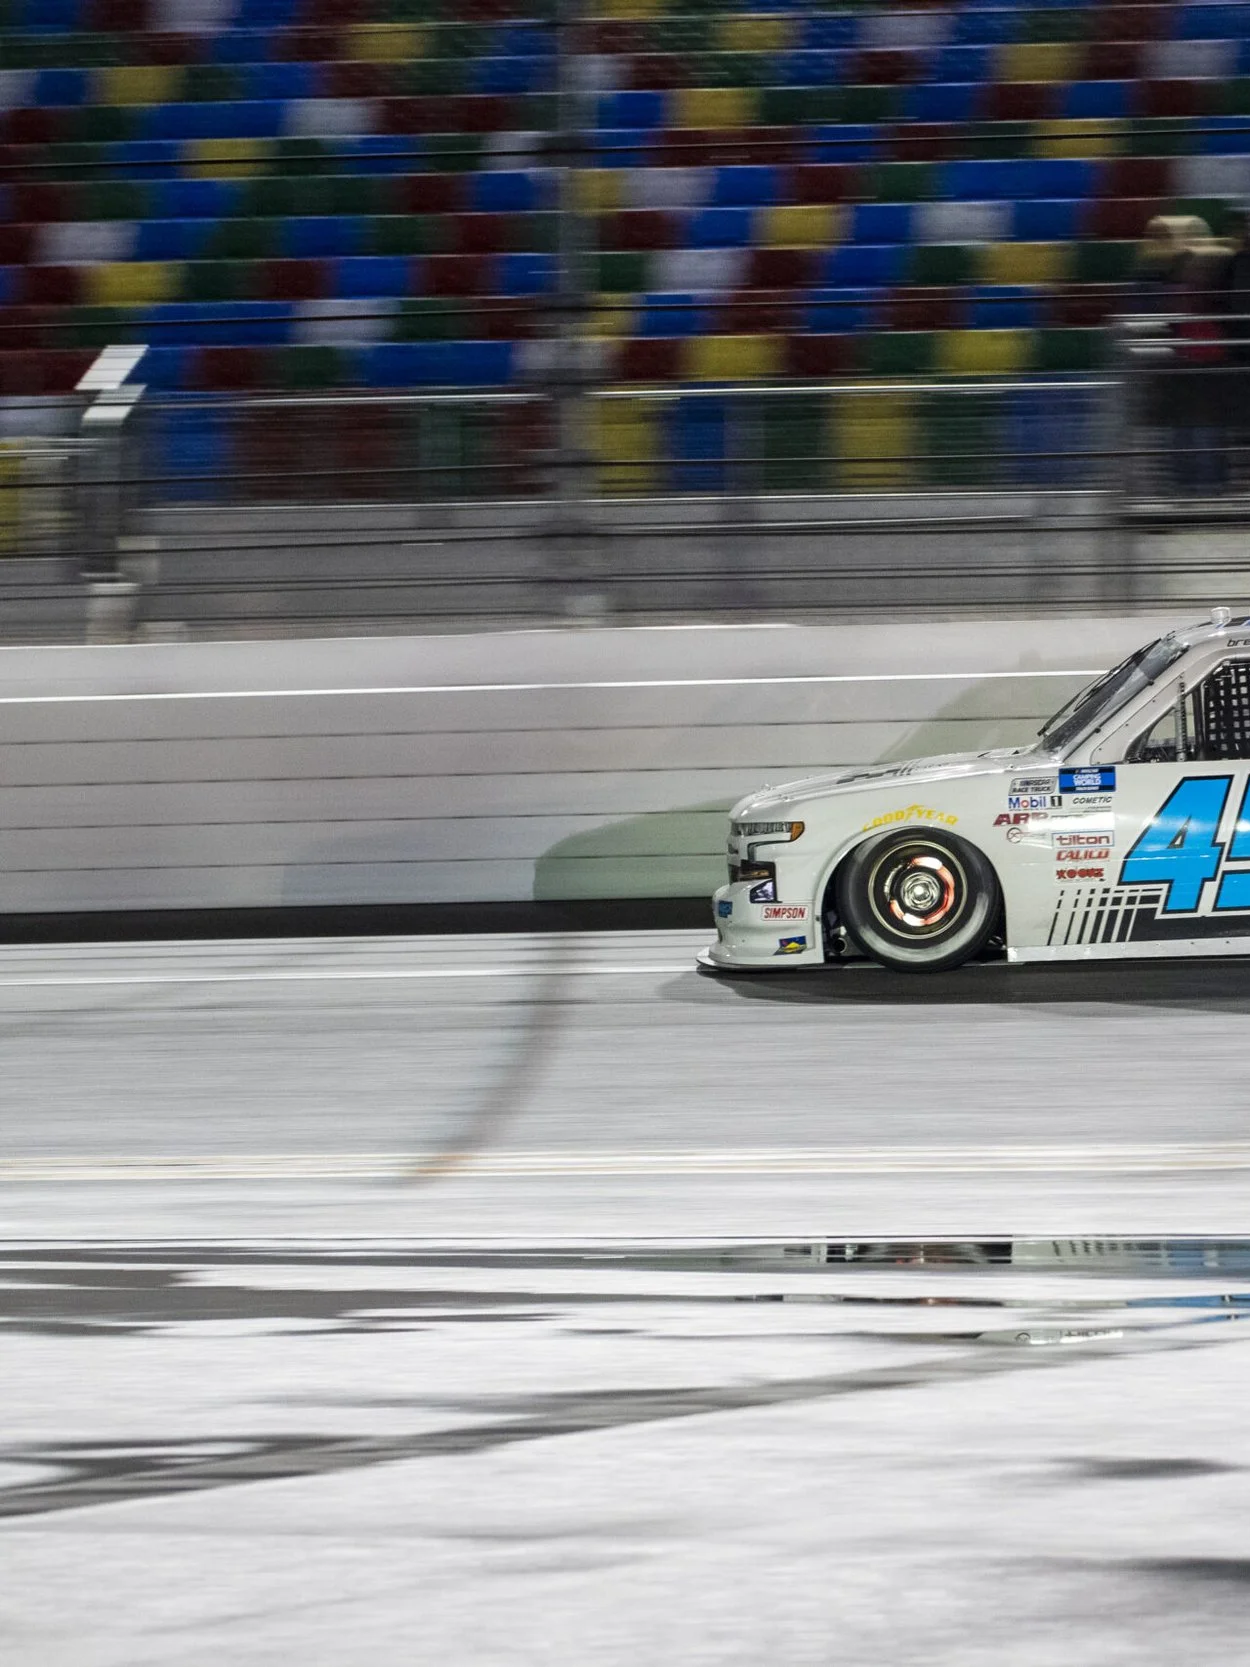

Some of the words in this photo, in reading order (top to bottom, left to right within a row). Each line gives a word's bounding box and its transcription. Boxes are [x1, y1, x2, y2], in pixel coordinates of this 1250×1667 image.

[1008, 796, 1047, 809] Mobil
[1072, 796, 1113, 805] COMETIC
[1056, 835, 1110, 846] tilton
[1056, 848, 1110, 862] CALICO
[764, 907, 806, 919] SIMPSON
